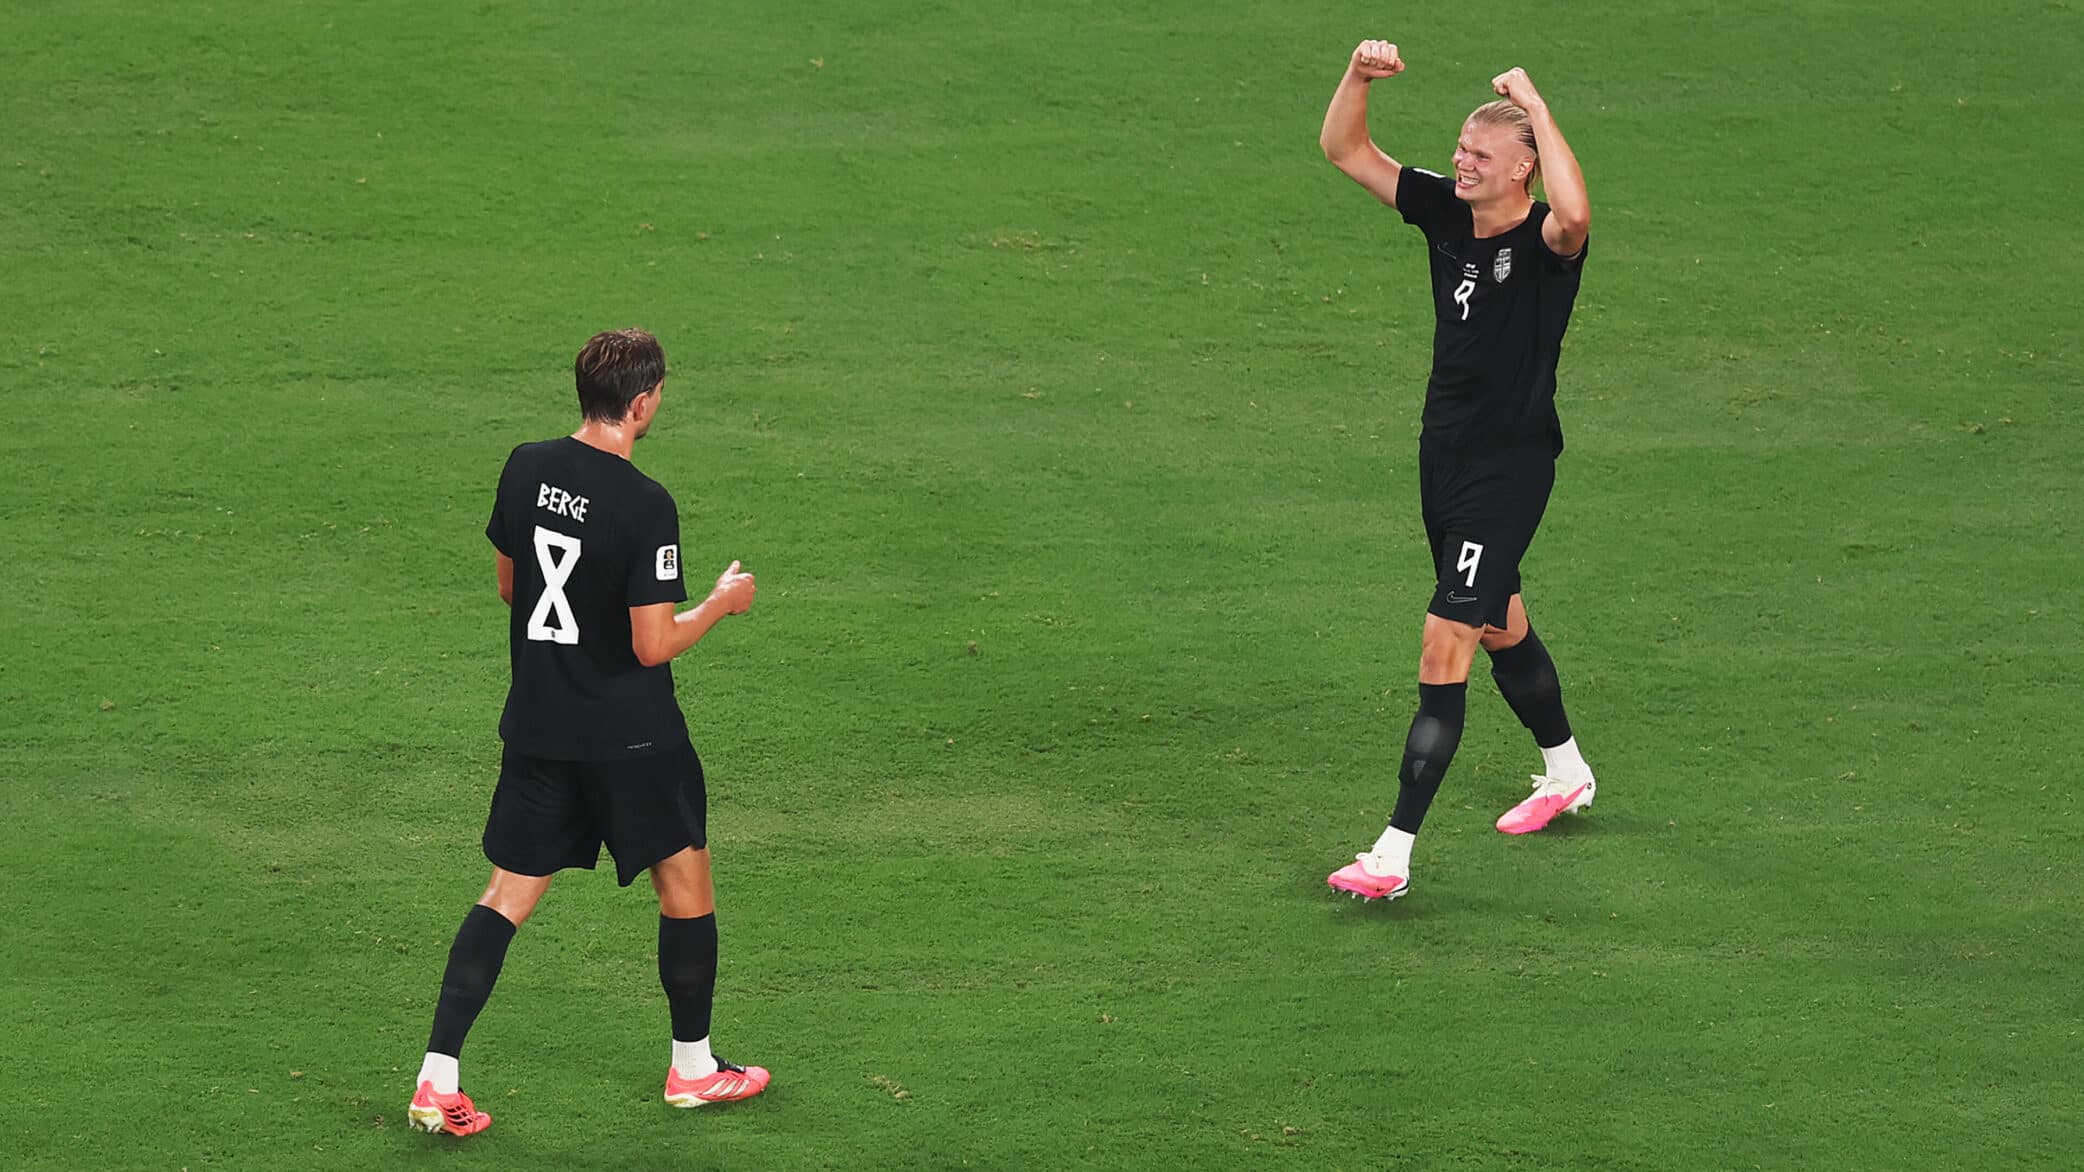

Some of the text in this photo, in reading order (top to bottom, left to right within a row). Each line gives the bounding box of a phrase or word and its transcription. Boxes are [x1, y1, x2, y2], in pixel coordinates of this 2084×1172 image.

[1454, 279, 1476, 321] 9
[537, 483, 590, 523] BERGE
[527, 525, 582, 645] 8
[1457, 540, 1484, 588] 9
